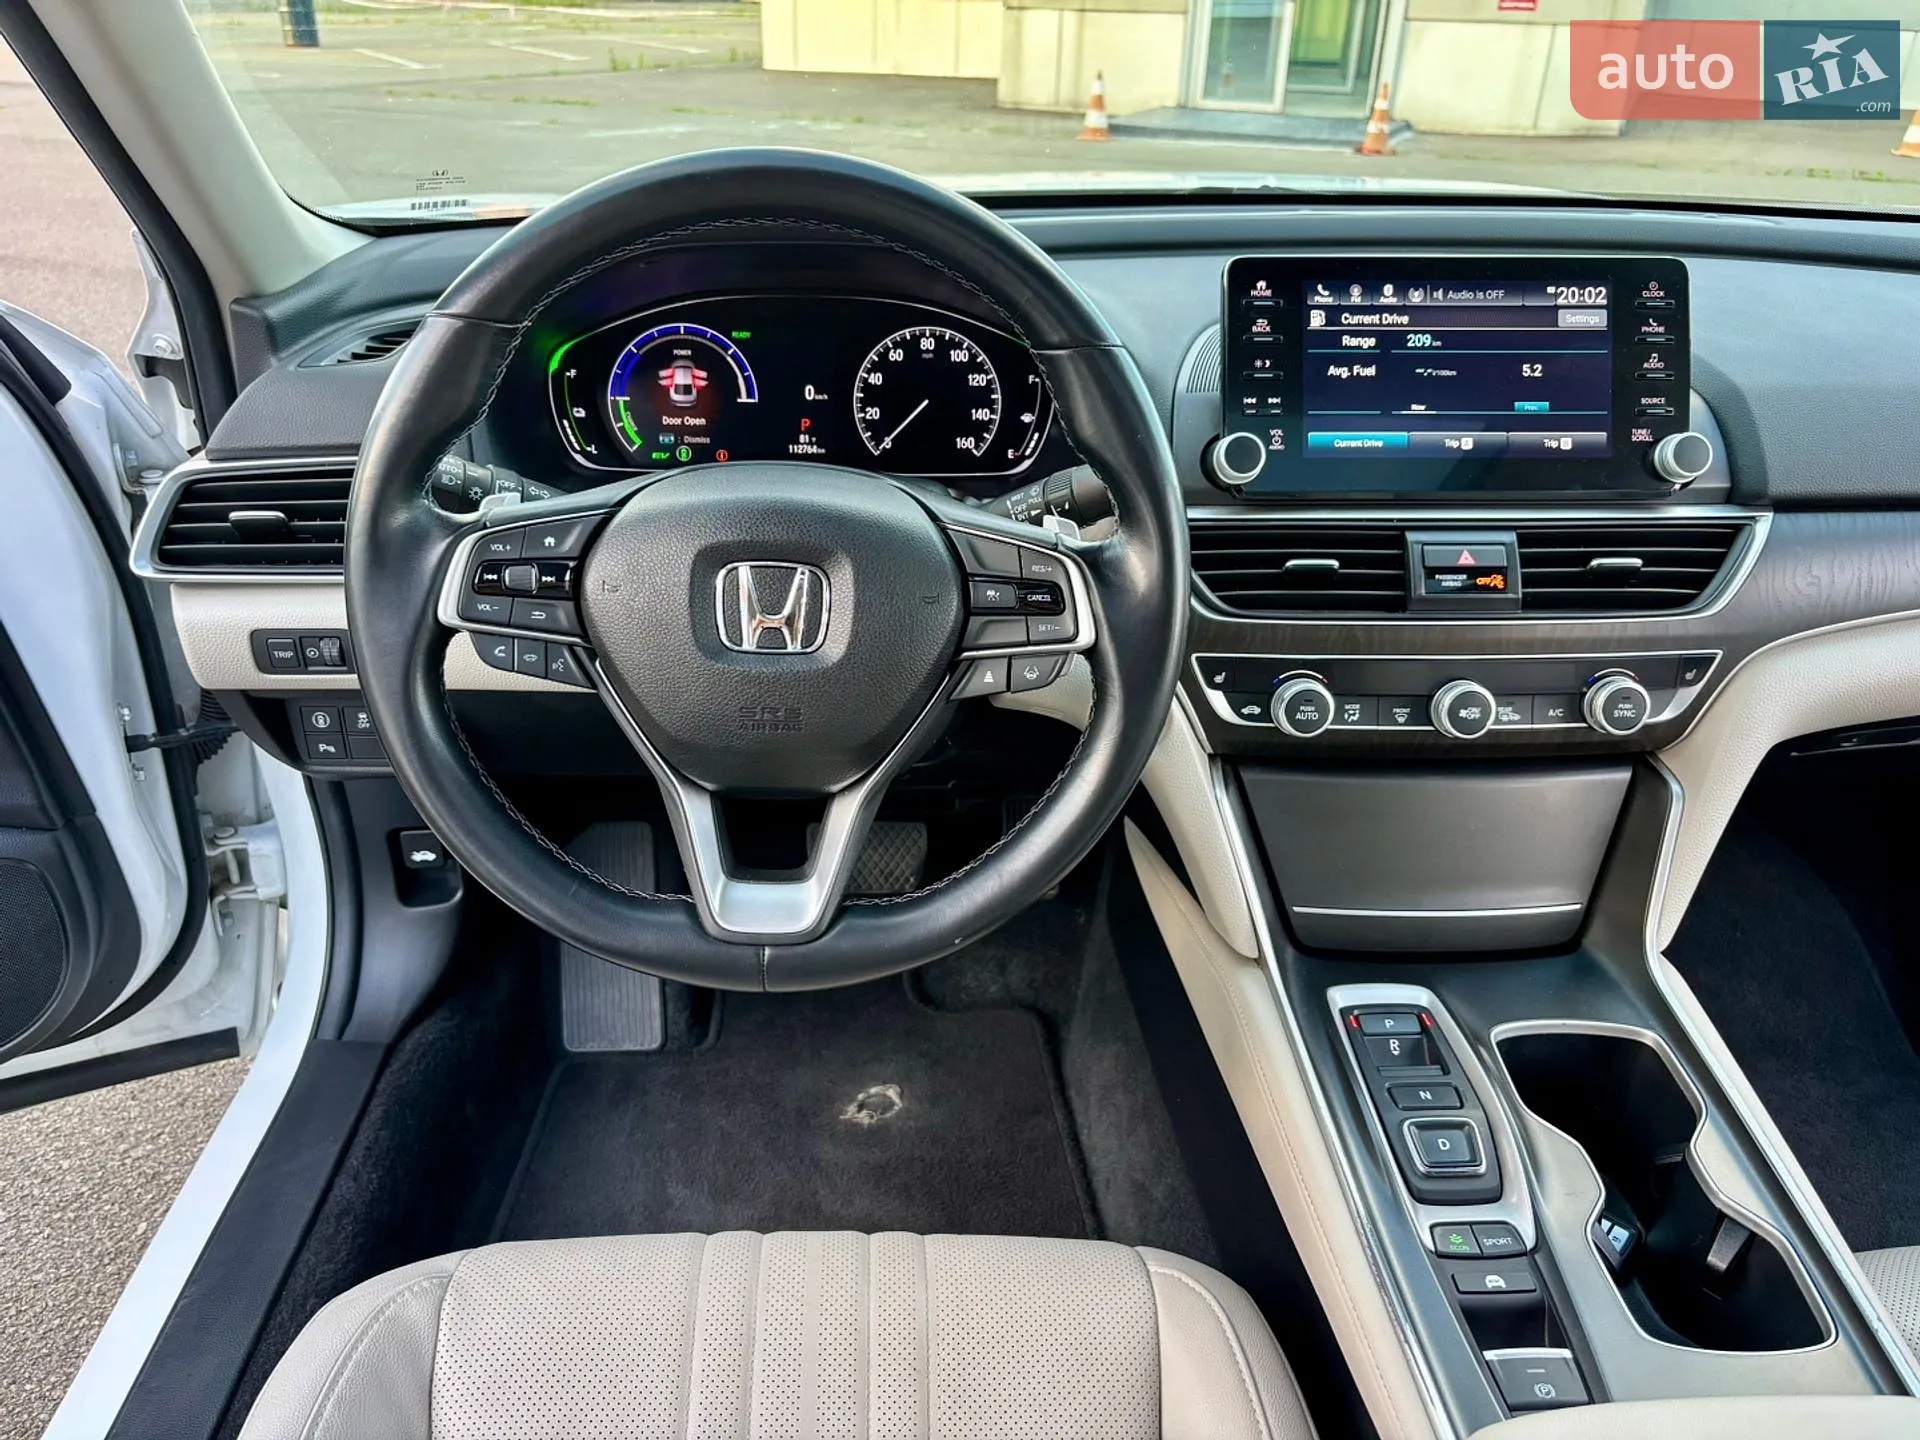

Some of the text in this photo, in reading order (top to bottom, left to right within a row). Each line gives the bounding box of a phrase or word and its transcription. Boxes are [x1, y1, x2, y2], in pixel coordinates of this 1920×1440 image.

[1448, 290, 1505, 300] Audio is OFF
[1557, 286, 1606, 302] 20:02
[1341, 313, 1409, 324] Current Drive
[1566, 314, 1600, 325] Settings
[920, 338, 934, 350] 80
[1342, 336, 1376, 348] Range
[1407, 334, 1431, 346] 209
[889, 350, 903, 361] 60
[951, 350, 968, 362] 100
[1328, 365, 1376, 378] Avg. Fuel
[1522, 364, 1542, 377] 5.2
[868, 373, 882, 385] 40
[968, 374, 986, 386] 120
[1029, 375, 1035, 384] F
[805, 385, 814, 400] 0
[866, 407, 880, 419] 20
[971, 409, 990, 421] 140
[662, 416, 706, 427] Door Open
[802, 419, 810, 432] P
[684, 435, 710, 444] Dismiss
[956, 437, 974, 449] 160
[1334, 439, 1384, 447] Current Drive
[1444, 439, 1460, 448] Trip
[1543, 439, 1558, 448] Trip
[789, 444, 817, 453] 112764
[1008, 449, 1014, 458] E
[1295, 712, 1318, 720] AUTO
[1548, 708, 1564, 716] A/C
[1613, 710, 1636, 718] SYNC
[1385, 1019, 1394, 1028] P
[1390, 1039, 1400, 1050] R
[1419, 1092, 1432, 1100] N
[1438, 1139, 1450, 1150] D
[1483, 1238, 1512, 1246] SPORT
